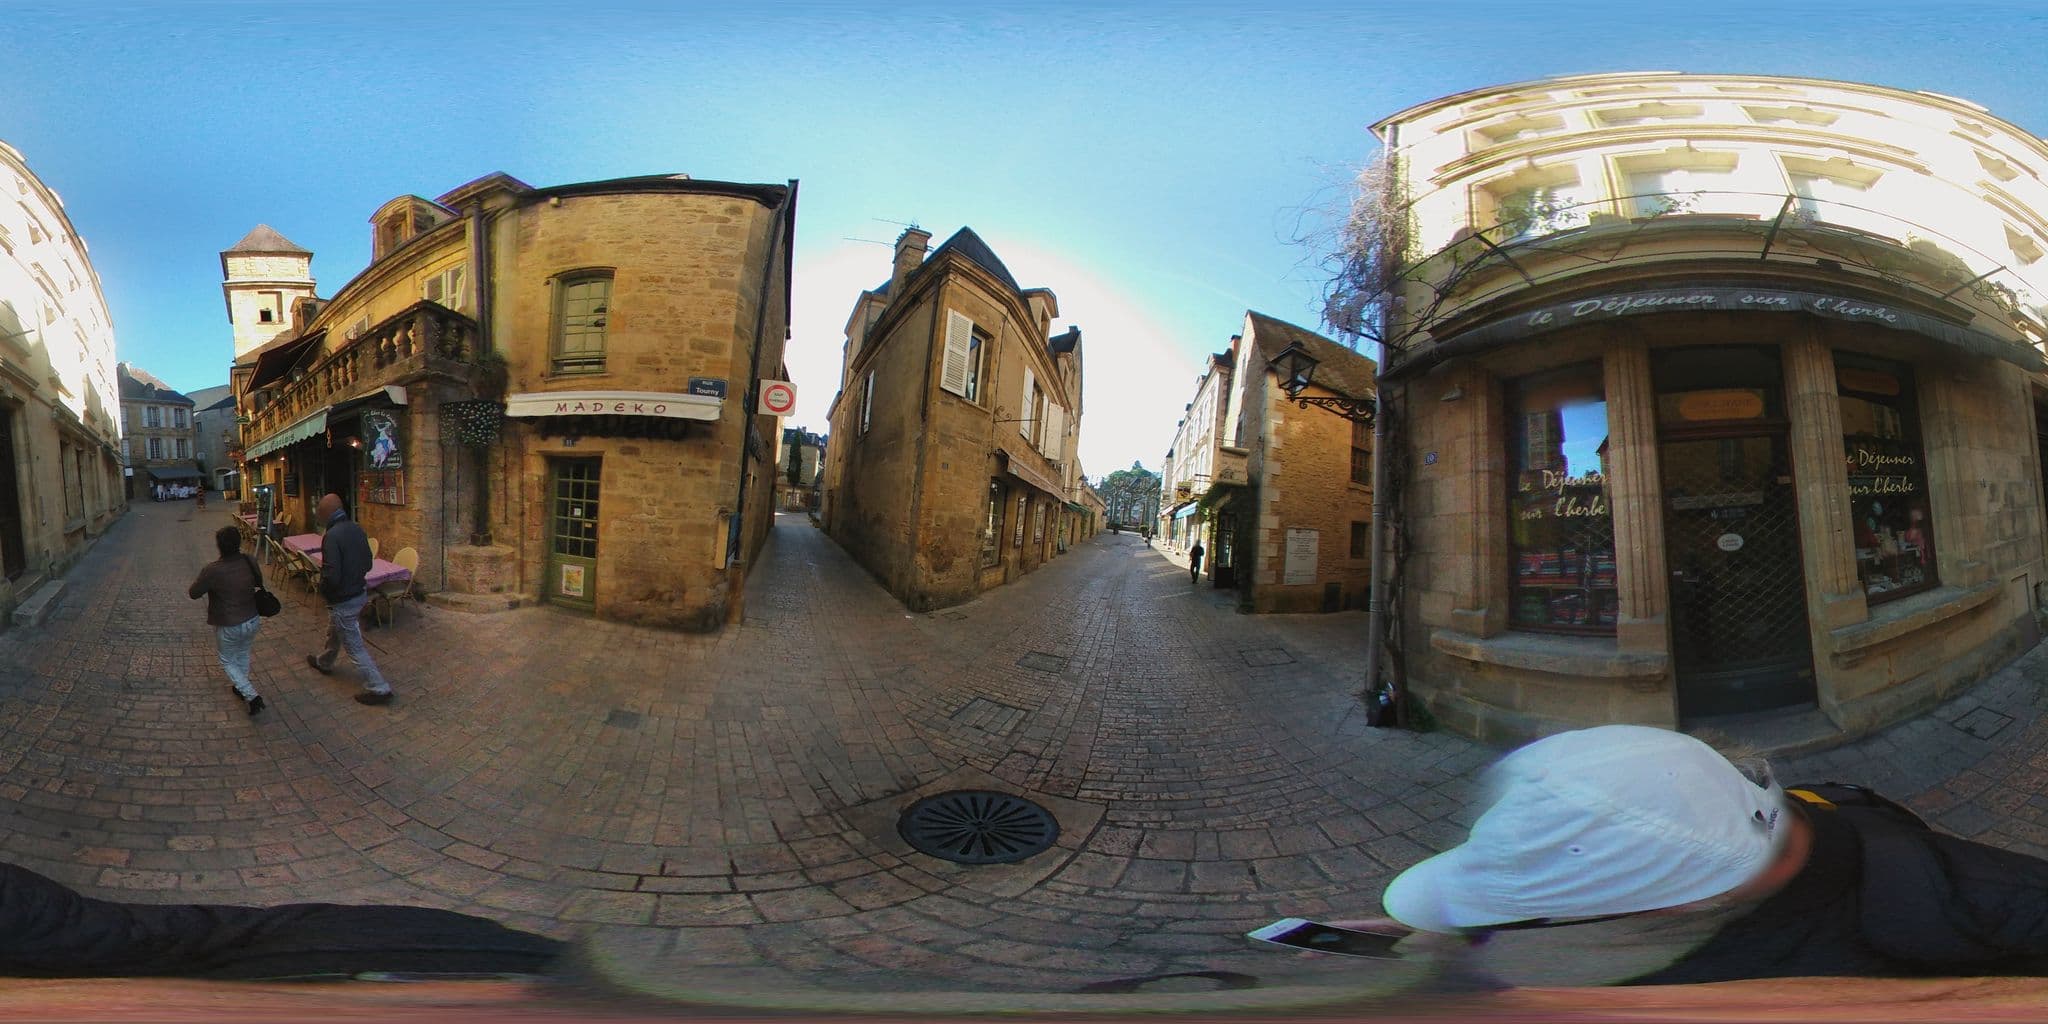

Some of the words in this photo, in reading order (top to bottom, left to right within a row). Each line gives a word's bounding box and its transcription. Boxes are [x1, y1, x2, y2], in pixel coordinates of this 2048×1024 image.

[1571, 295, 1717, 318] Déjeuner
[1740, 294, 1790, 306] sur
[1814, 297, 1897, 323] l'herbe
[696, 387, 720, 397] Tourny
[554, 402, 667, 414] MADEKO
[1858, 449, 1914, 471] Déjeuner
[1541, 469, 1608, 495] Déjeuner
[1873, 476, 1915, 494] l'herbe
[1554, 495, 1605, 518] l'herbe
